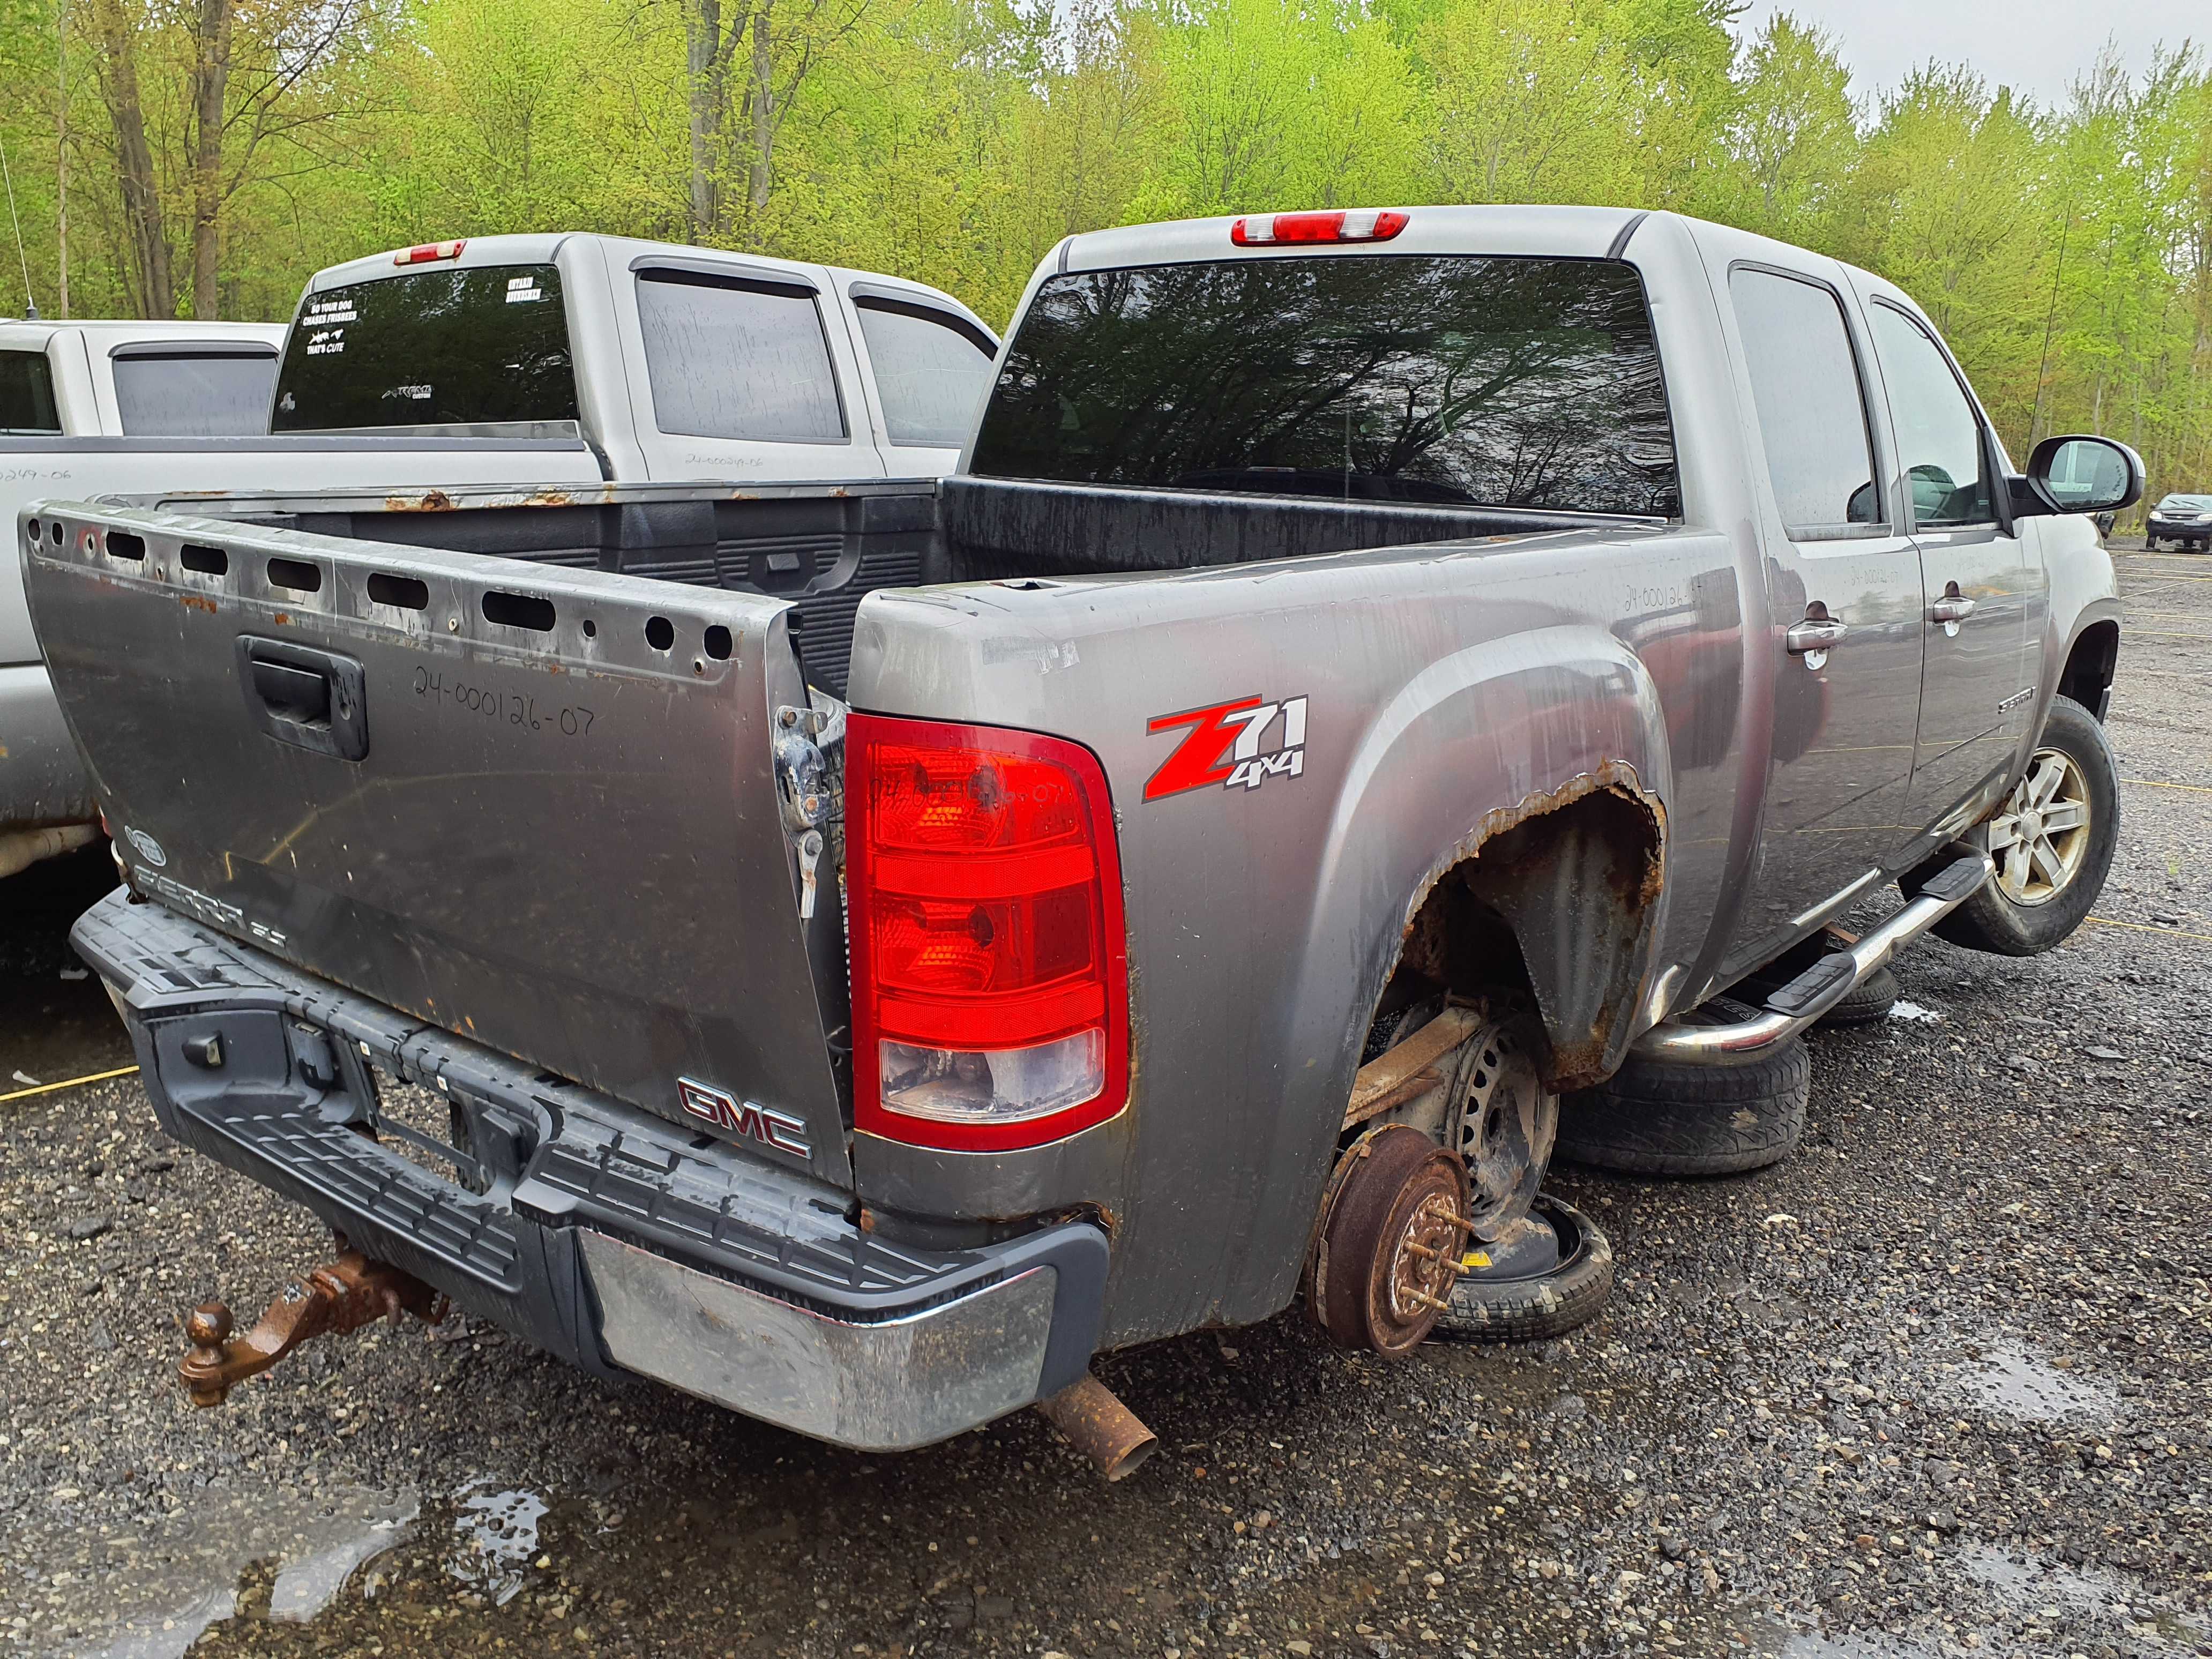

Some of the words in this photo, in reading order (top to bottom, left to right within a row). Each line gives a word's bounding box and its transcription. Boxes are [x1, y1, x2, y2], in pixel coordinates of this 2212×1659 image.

[303, 314, 327, 326] CHASES
[326, 310, 357, 324] FRISBEES
[311, 304, 320, 314] SO
[321, 302, 338, 313] YOUR
[338, 300, 353, 311] DOG
[307, 343, 326, 355] THAT'S
[326, 342, 345, 354] CUTE
[414, 666, 594, 736] 24-000126-07
[1141, 694, 1309, 804] Z71
[677, 1076, 814, 1160] GMC
